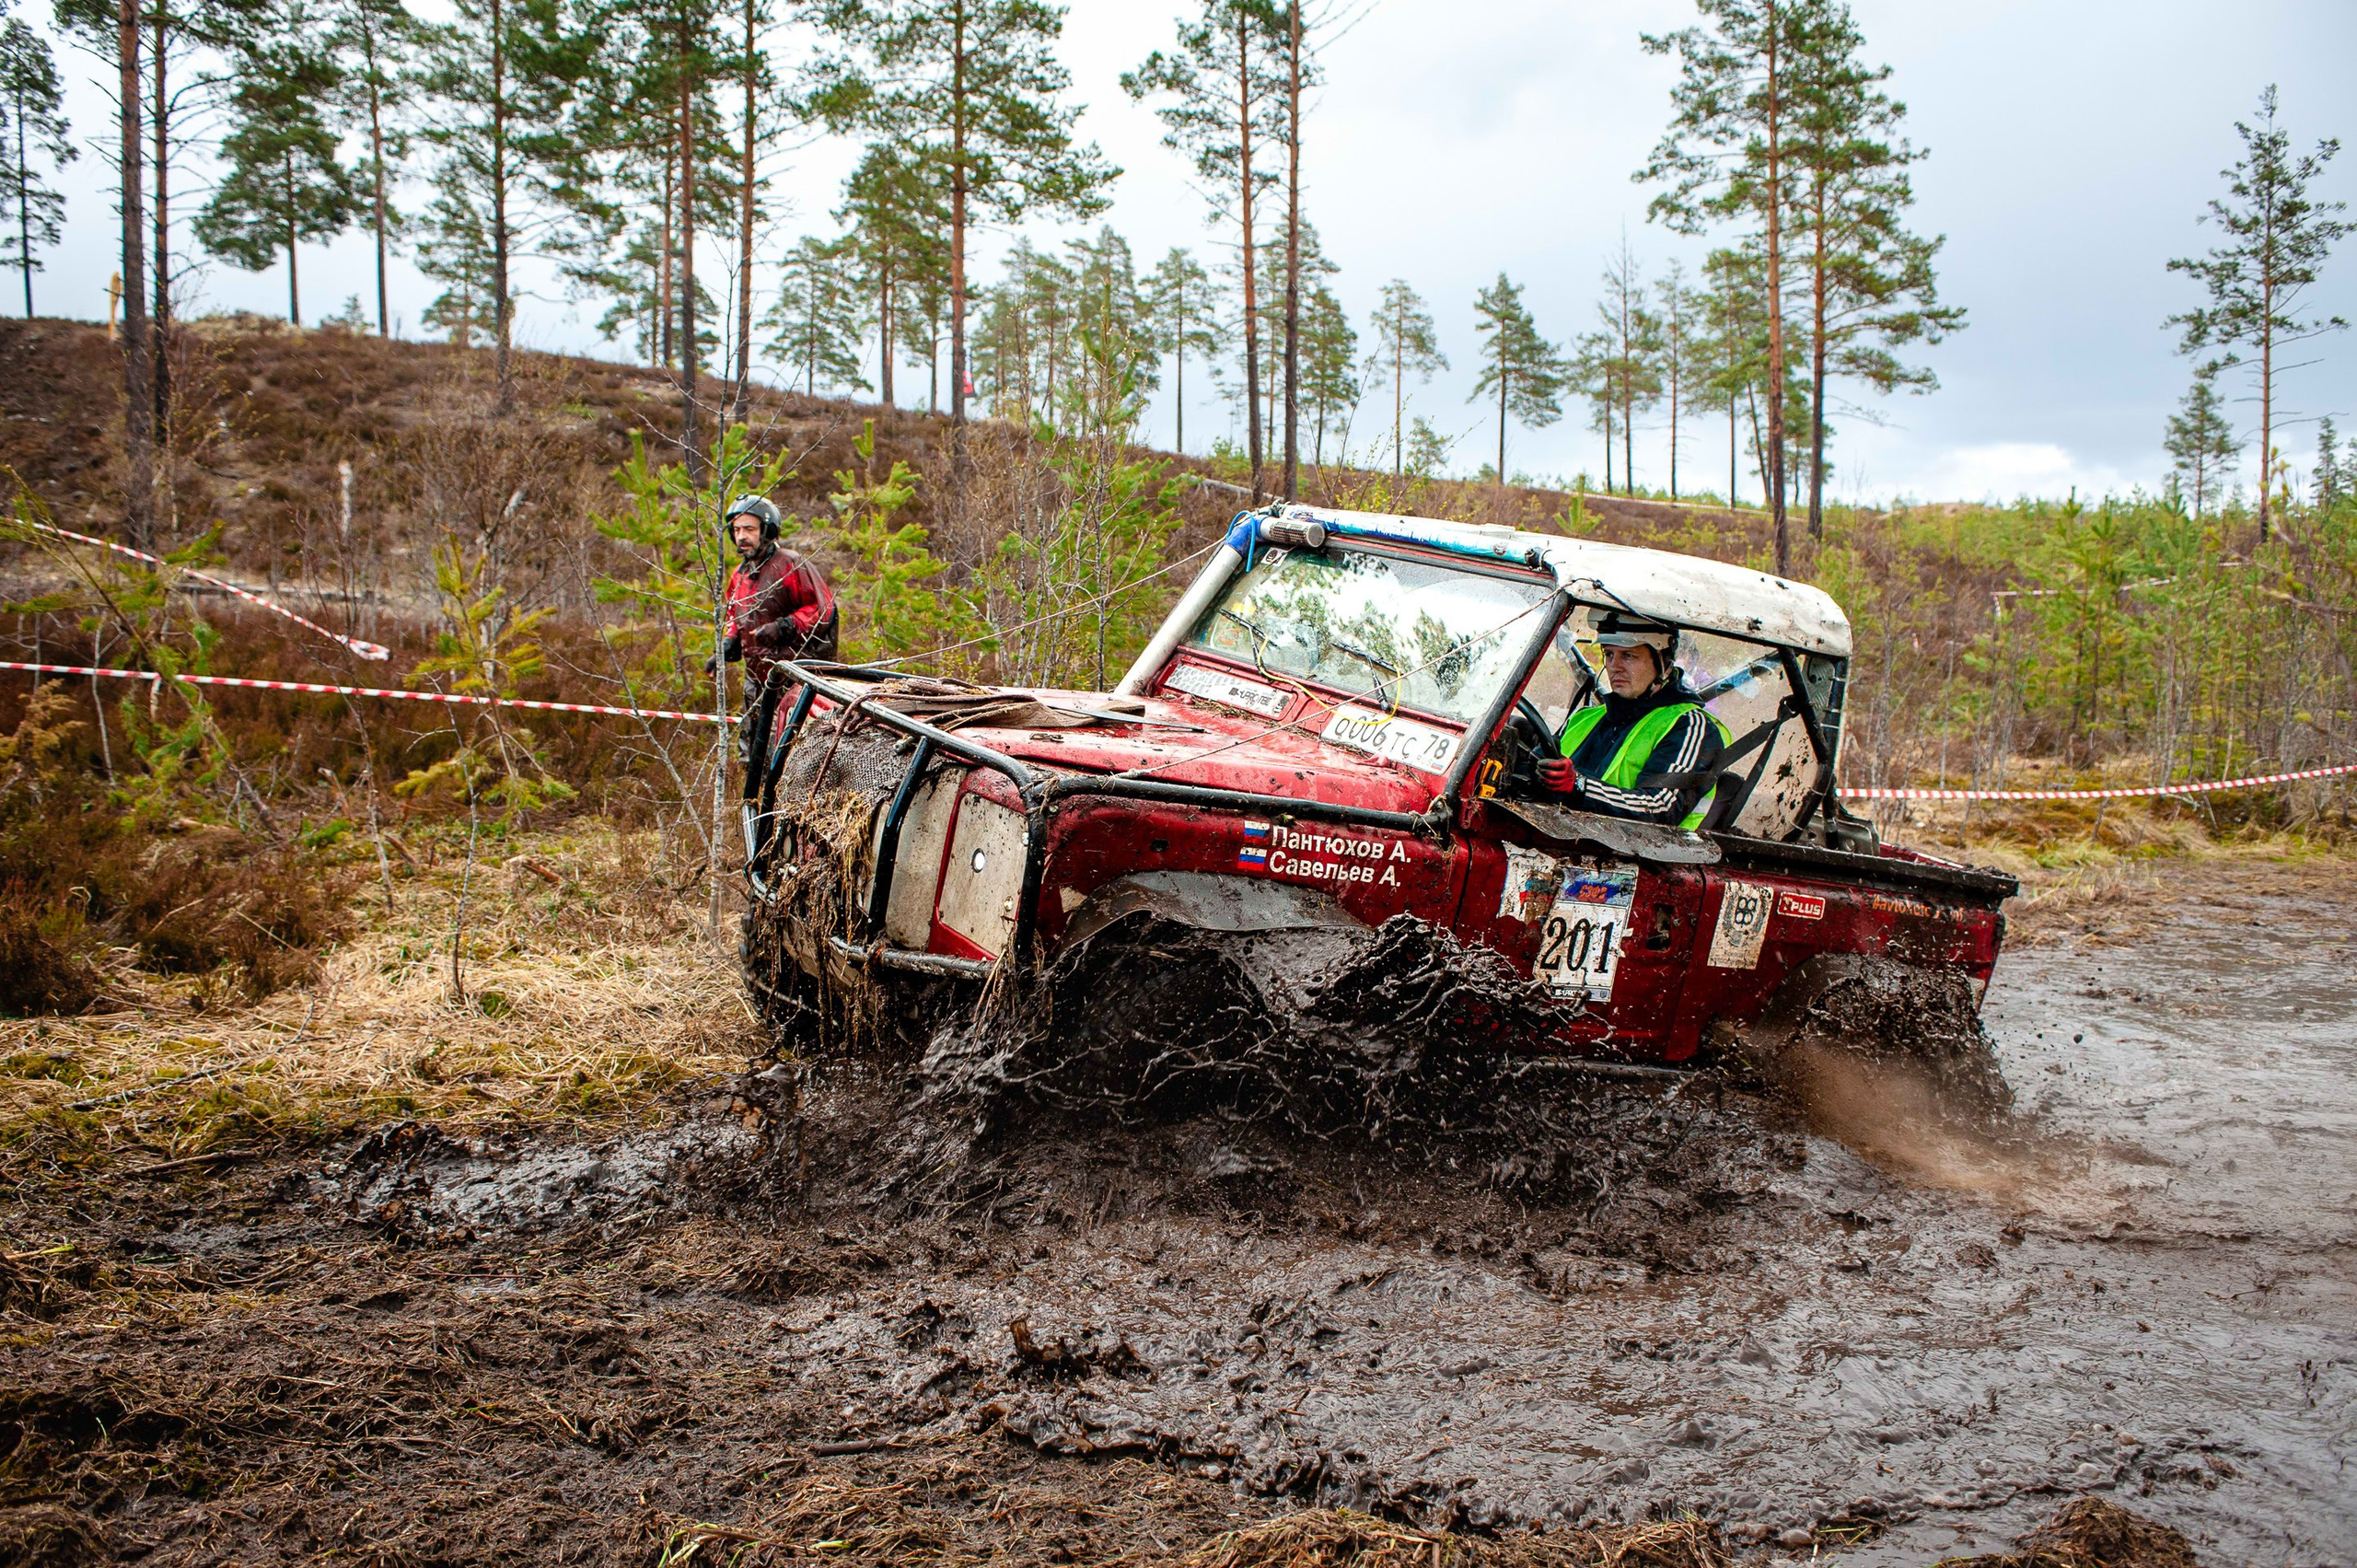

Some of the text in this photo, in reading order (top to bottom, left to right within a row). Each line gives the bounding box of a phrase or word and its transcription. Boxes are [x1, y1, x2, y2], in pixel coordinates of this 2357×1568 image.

[1423, 734, 1450, 760] 78
[1271, 825, 1412, 864] Пантюхов А.
[1269, 851, 1401, 888] Савельев А.
[1539, 917, 1614, 974] 201
